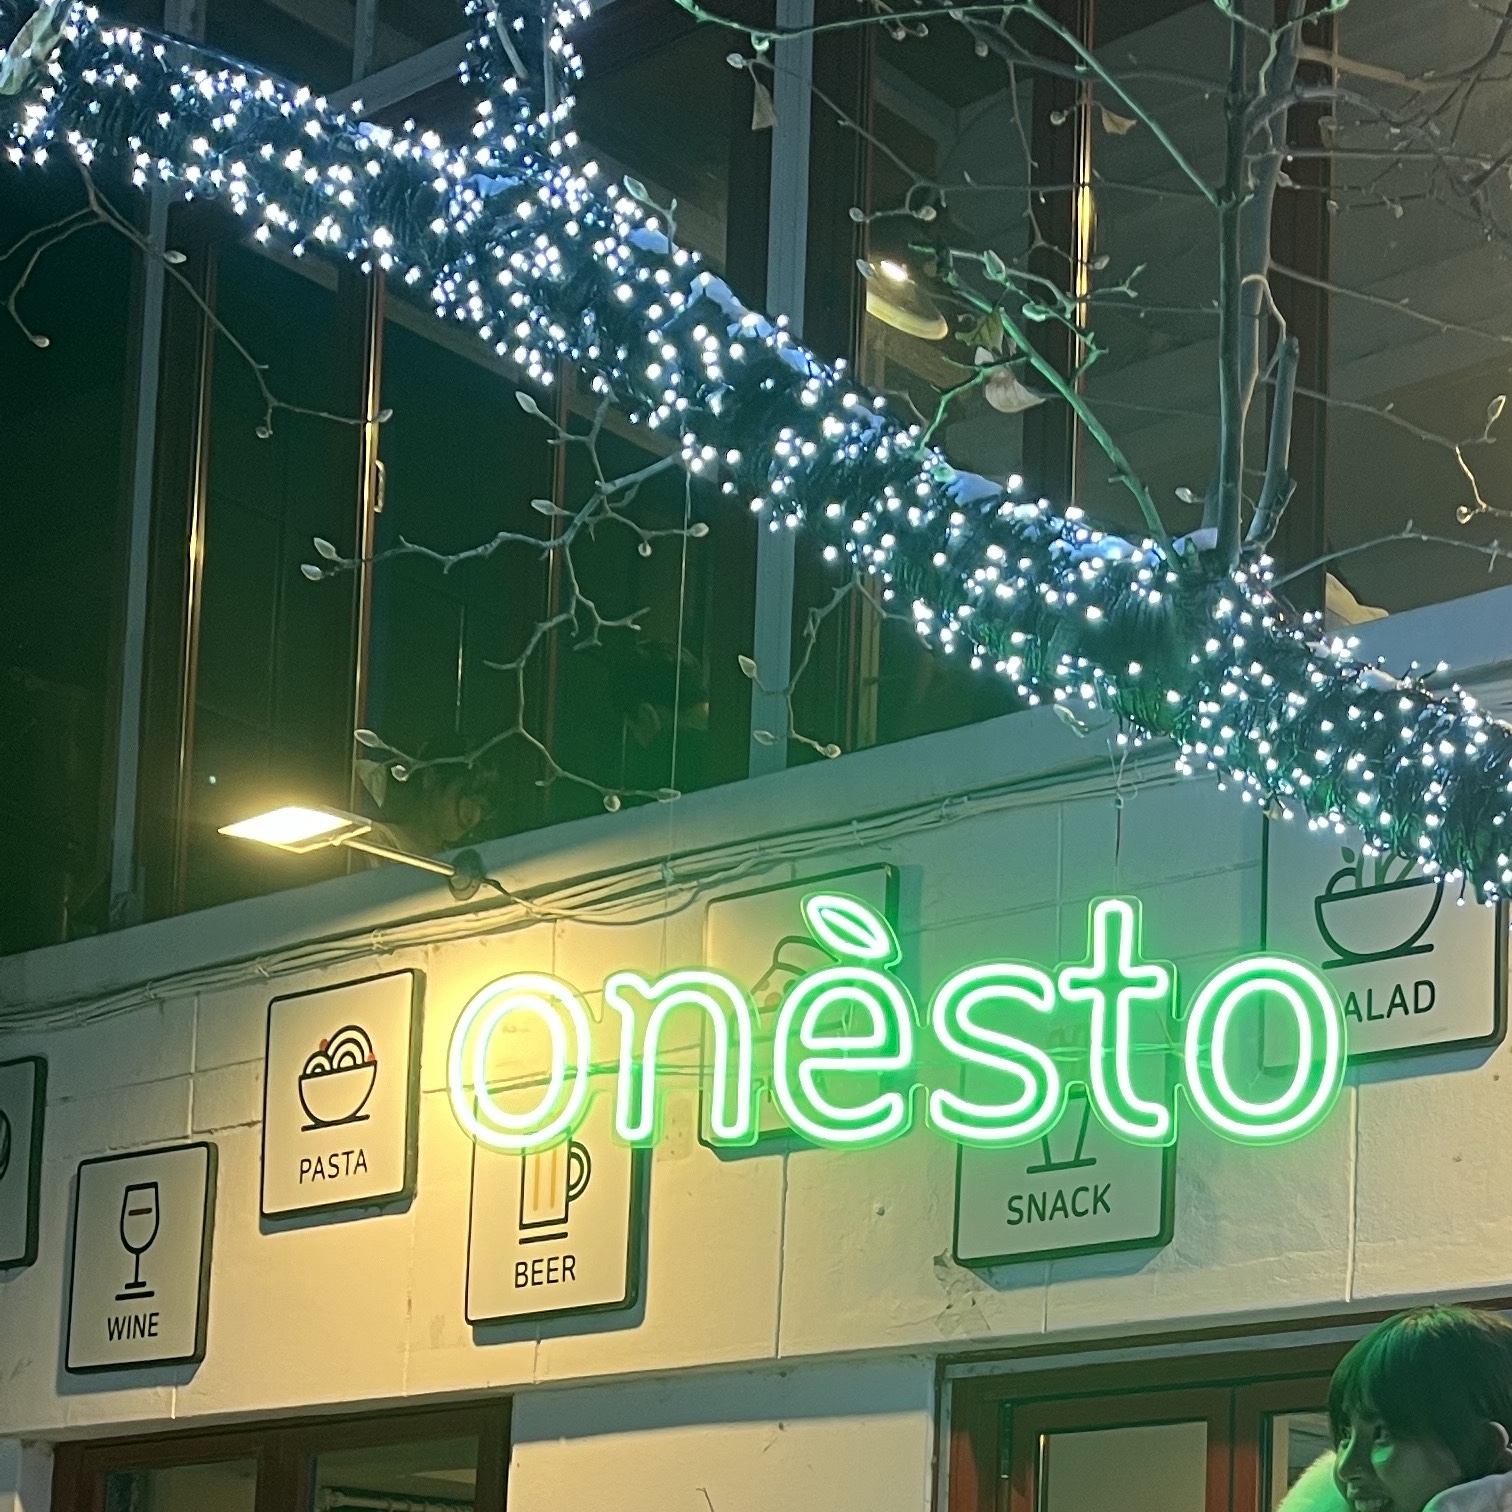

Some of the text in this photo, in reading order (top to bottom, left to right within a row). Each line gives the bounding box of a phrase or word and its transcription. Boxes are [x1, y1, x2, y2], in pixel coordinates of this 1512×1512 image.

[1344, 979, 1436, 1023] ALAD
[298, 1149, 369, 1185] PASTA
[1006, 1182, 1112, 1226] SNACK
[513, 1255, 577, 1289] BEER
[106, 1312, 160, 1342] WINE
